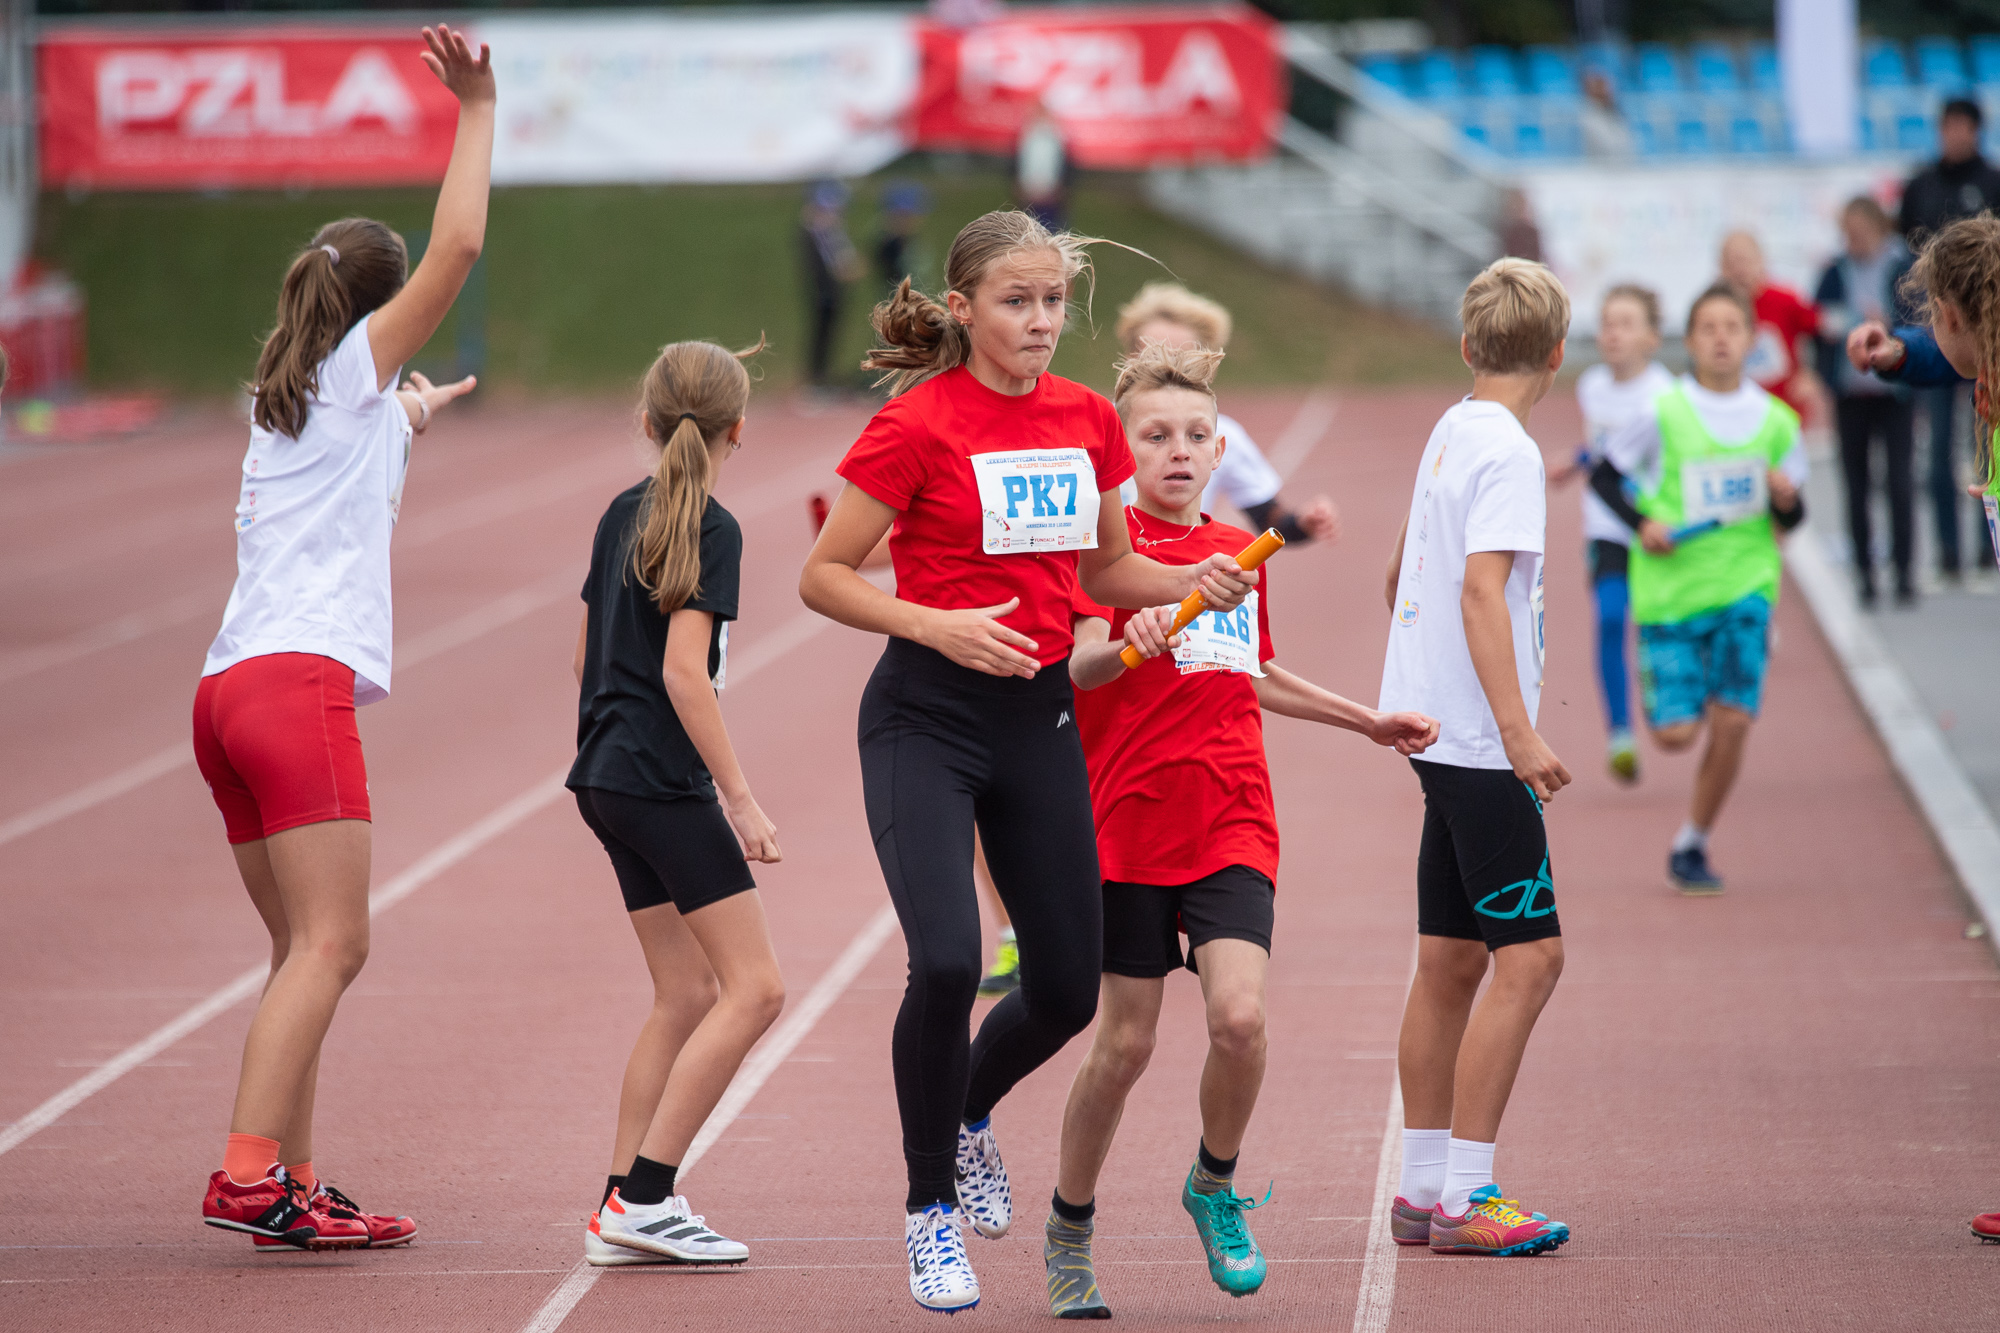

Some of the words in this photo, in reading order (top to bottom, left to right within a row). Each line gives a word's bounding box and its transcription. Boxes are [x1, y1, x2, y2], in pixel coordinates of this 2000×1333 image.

[96, 48, 418, 138] PZLA
[957, 27, 1241, 118] PZLA
[1002, 473, 1078, 518] PK7
[1182, 662, 1215, 674] NAJLEPSI
